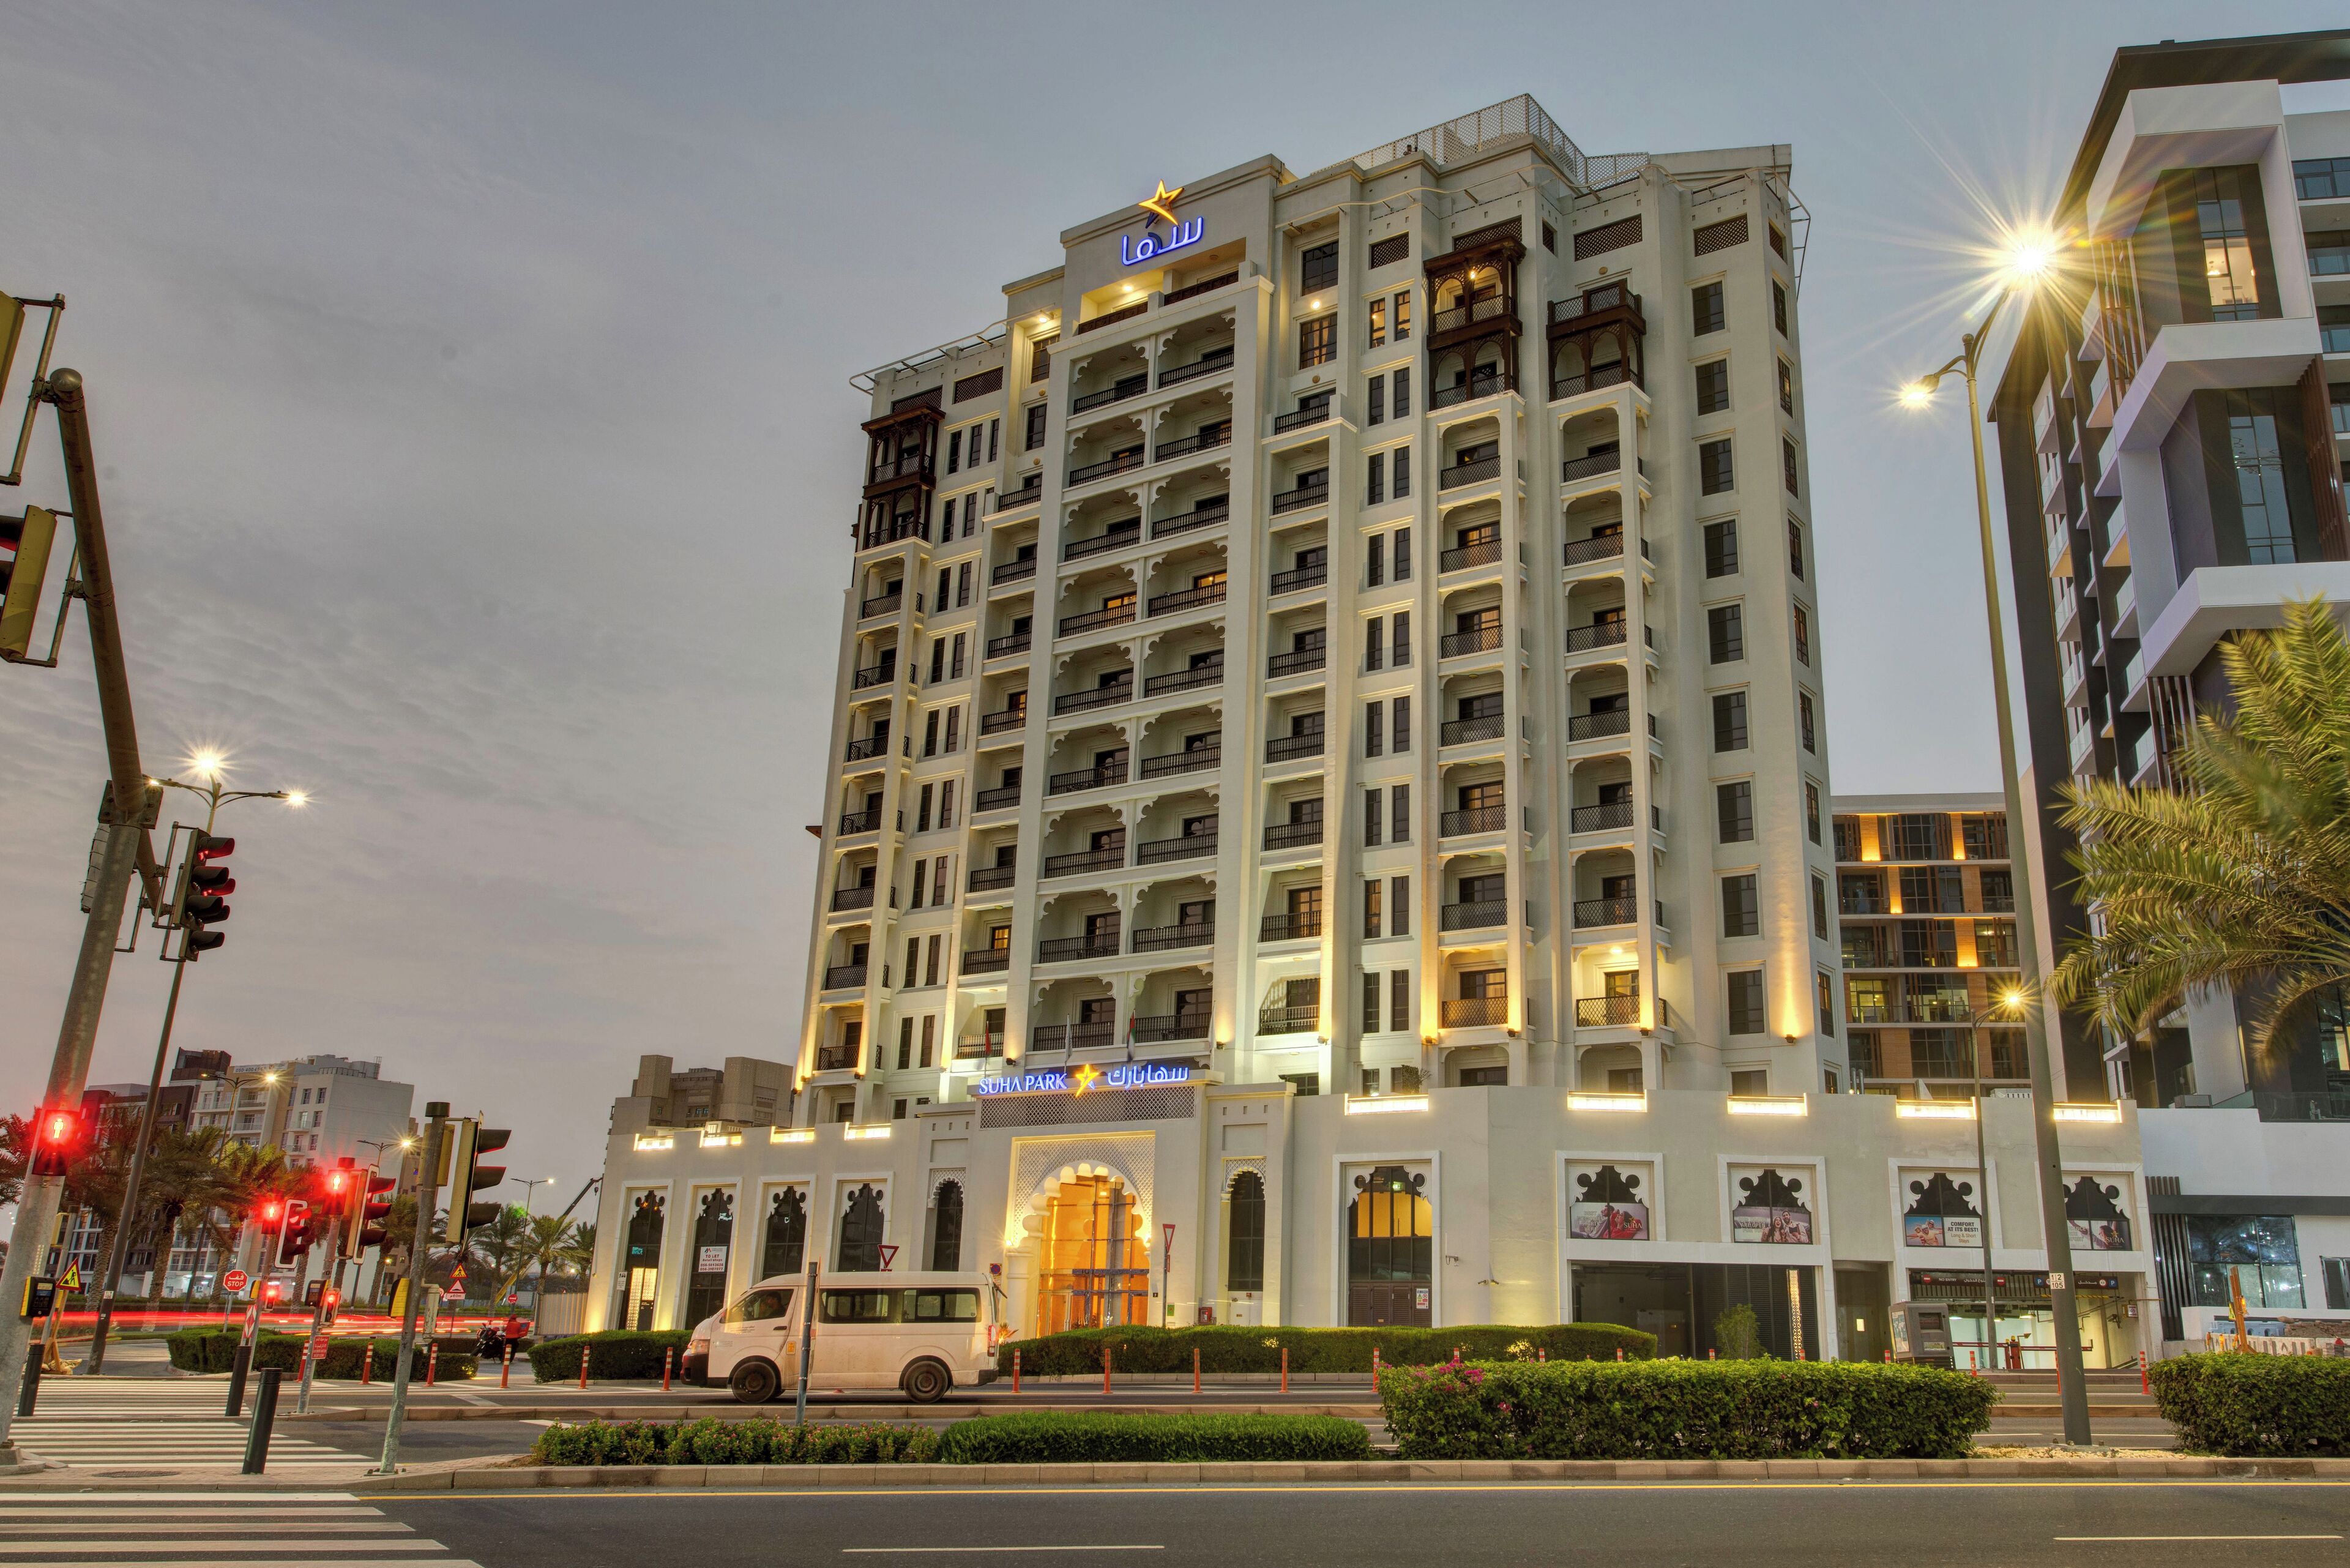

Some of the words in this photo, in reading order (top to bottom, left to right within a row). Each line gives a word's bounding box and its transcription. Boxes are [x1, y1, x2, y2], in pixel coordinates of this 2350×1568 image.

[1122, 216, 1203, 266] سها
[979, 1076, 1023, 1094] SUHA
[1025, 1073, 1068, 1091] PARK
